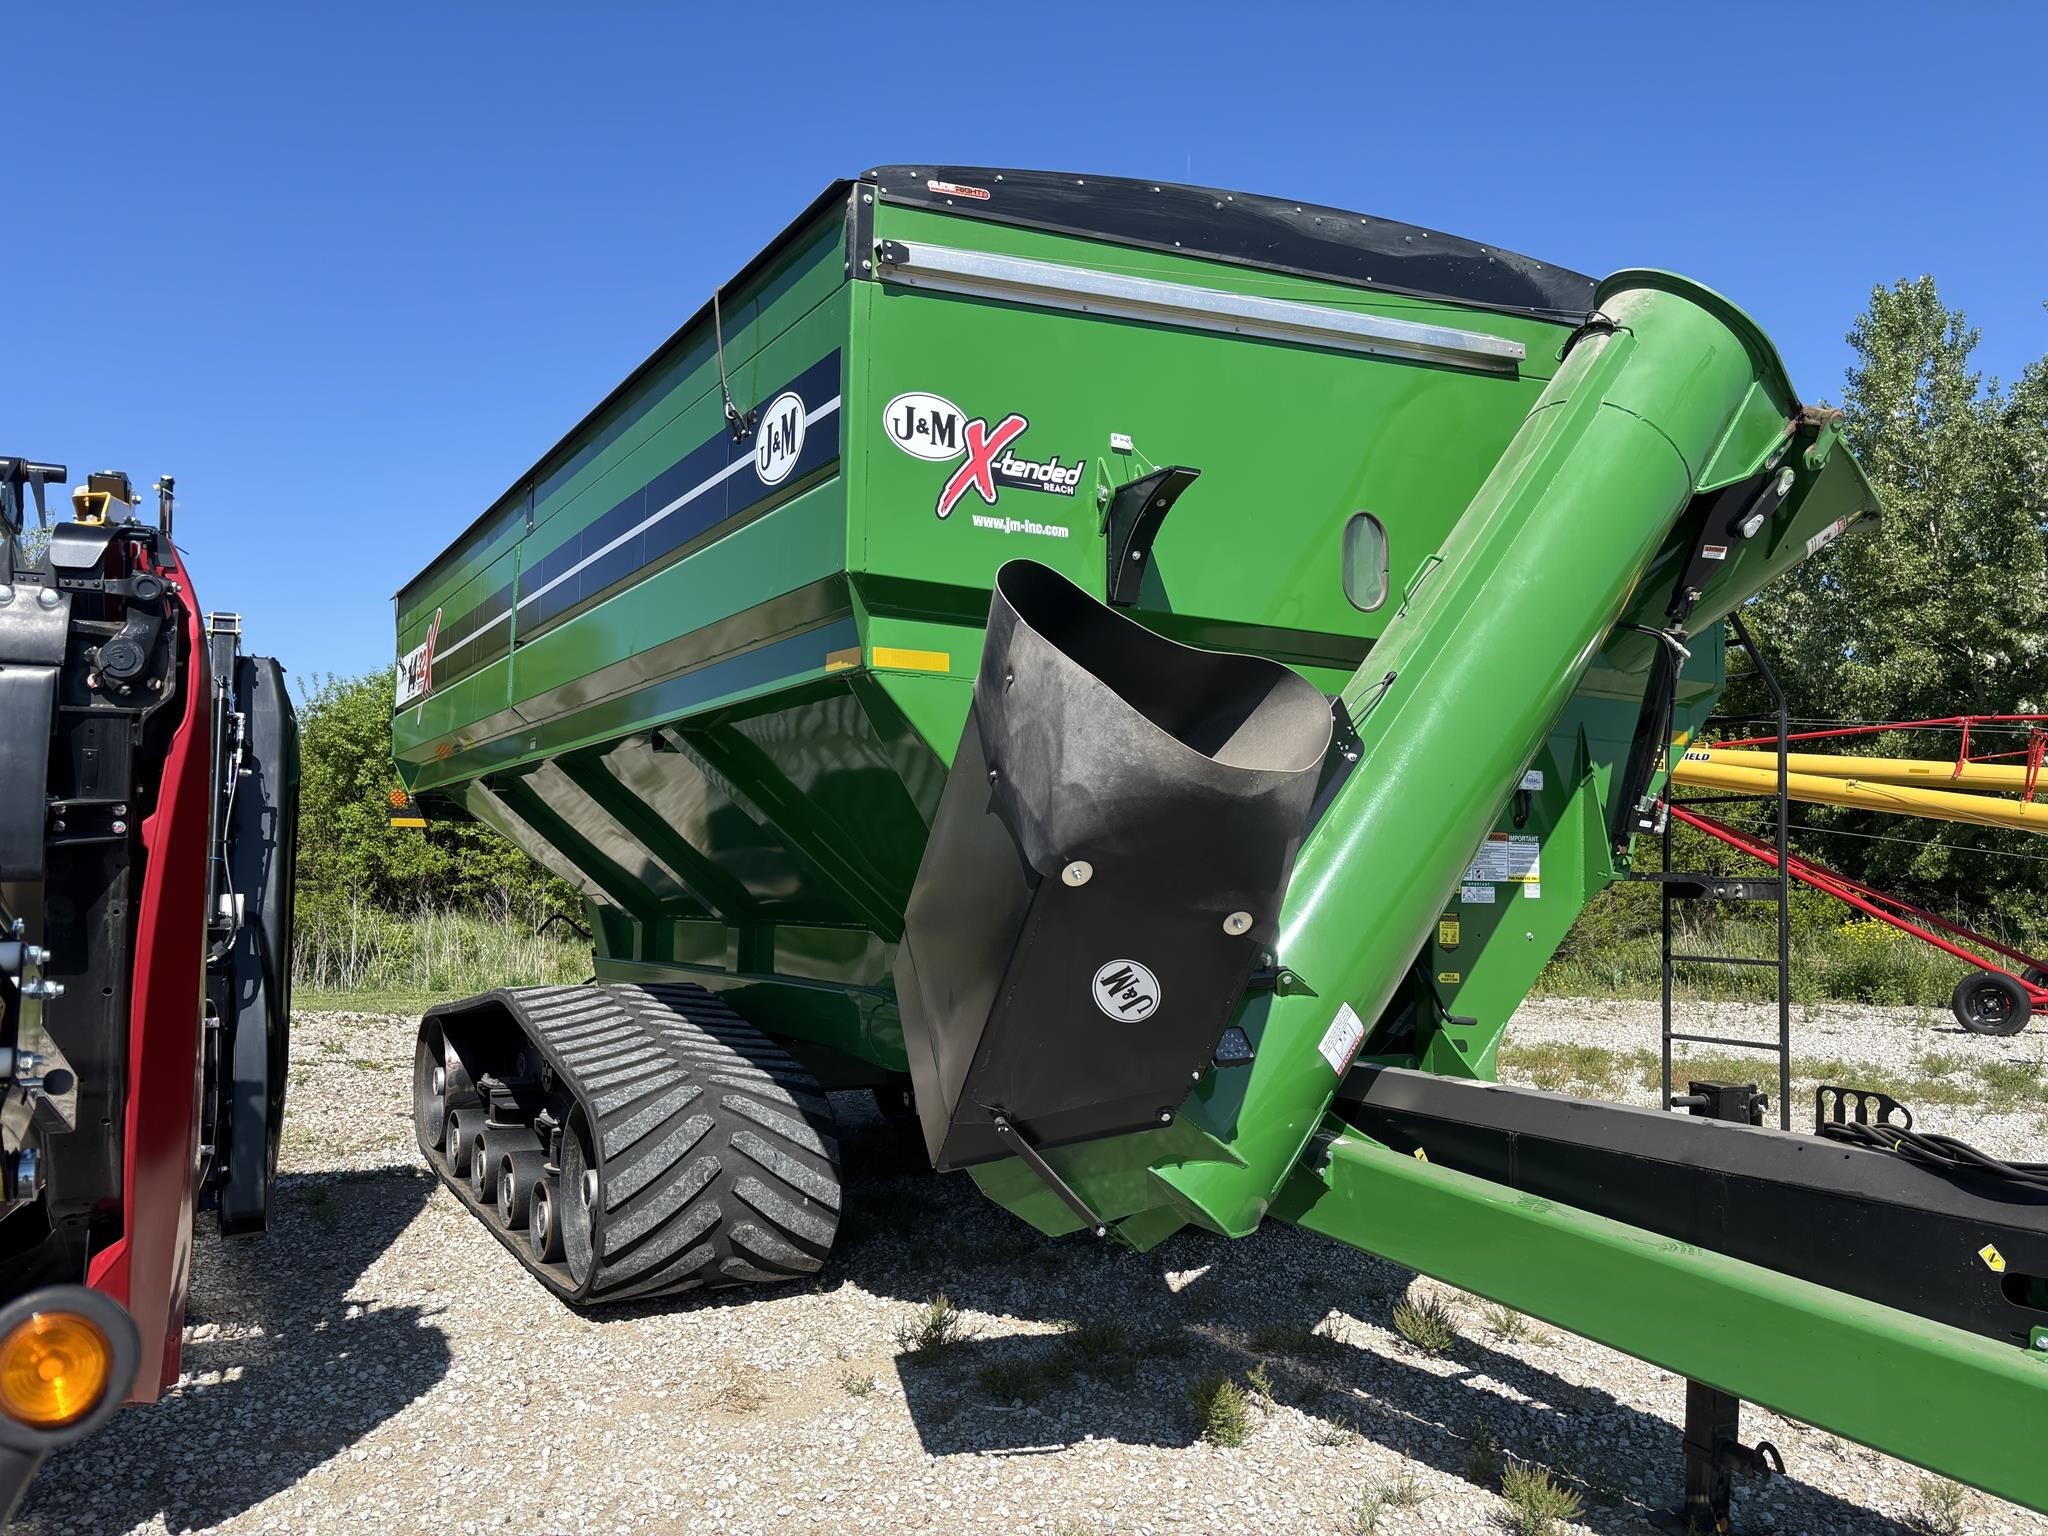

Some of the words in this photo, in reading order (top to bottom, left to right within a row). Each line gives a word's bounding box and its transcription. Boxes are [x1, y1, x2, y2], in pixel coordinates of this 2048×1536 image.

[760, 406, 798, 471] J&M
[893, 405, 958, 449] J&M
[1043, 482, 1074, 495] REACH
[972, 514, 1069, 538] www.jm-inc.com
[1684, 752, 1711, 761] IELD
[1508, 834, 1539, 842] IMPORTANT
[1100, 965, 1153, 1014] J&M
